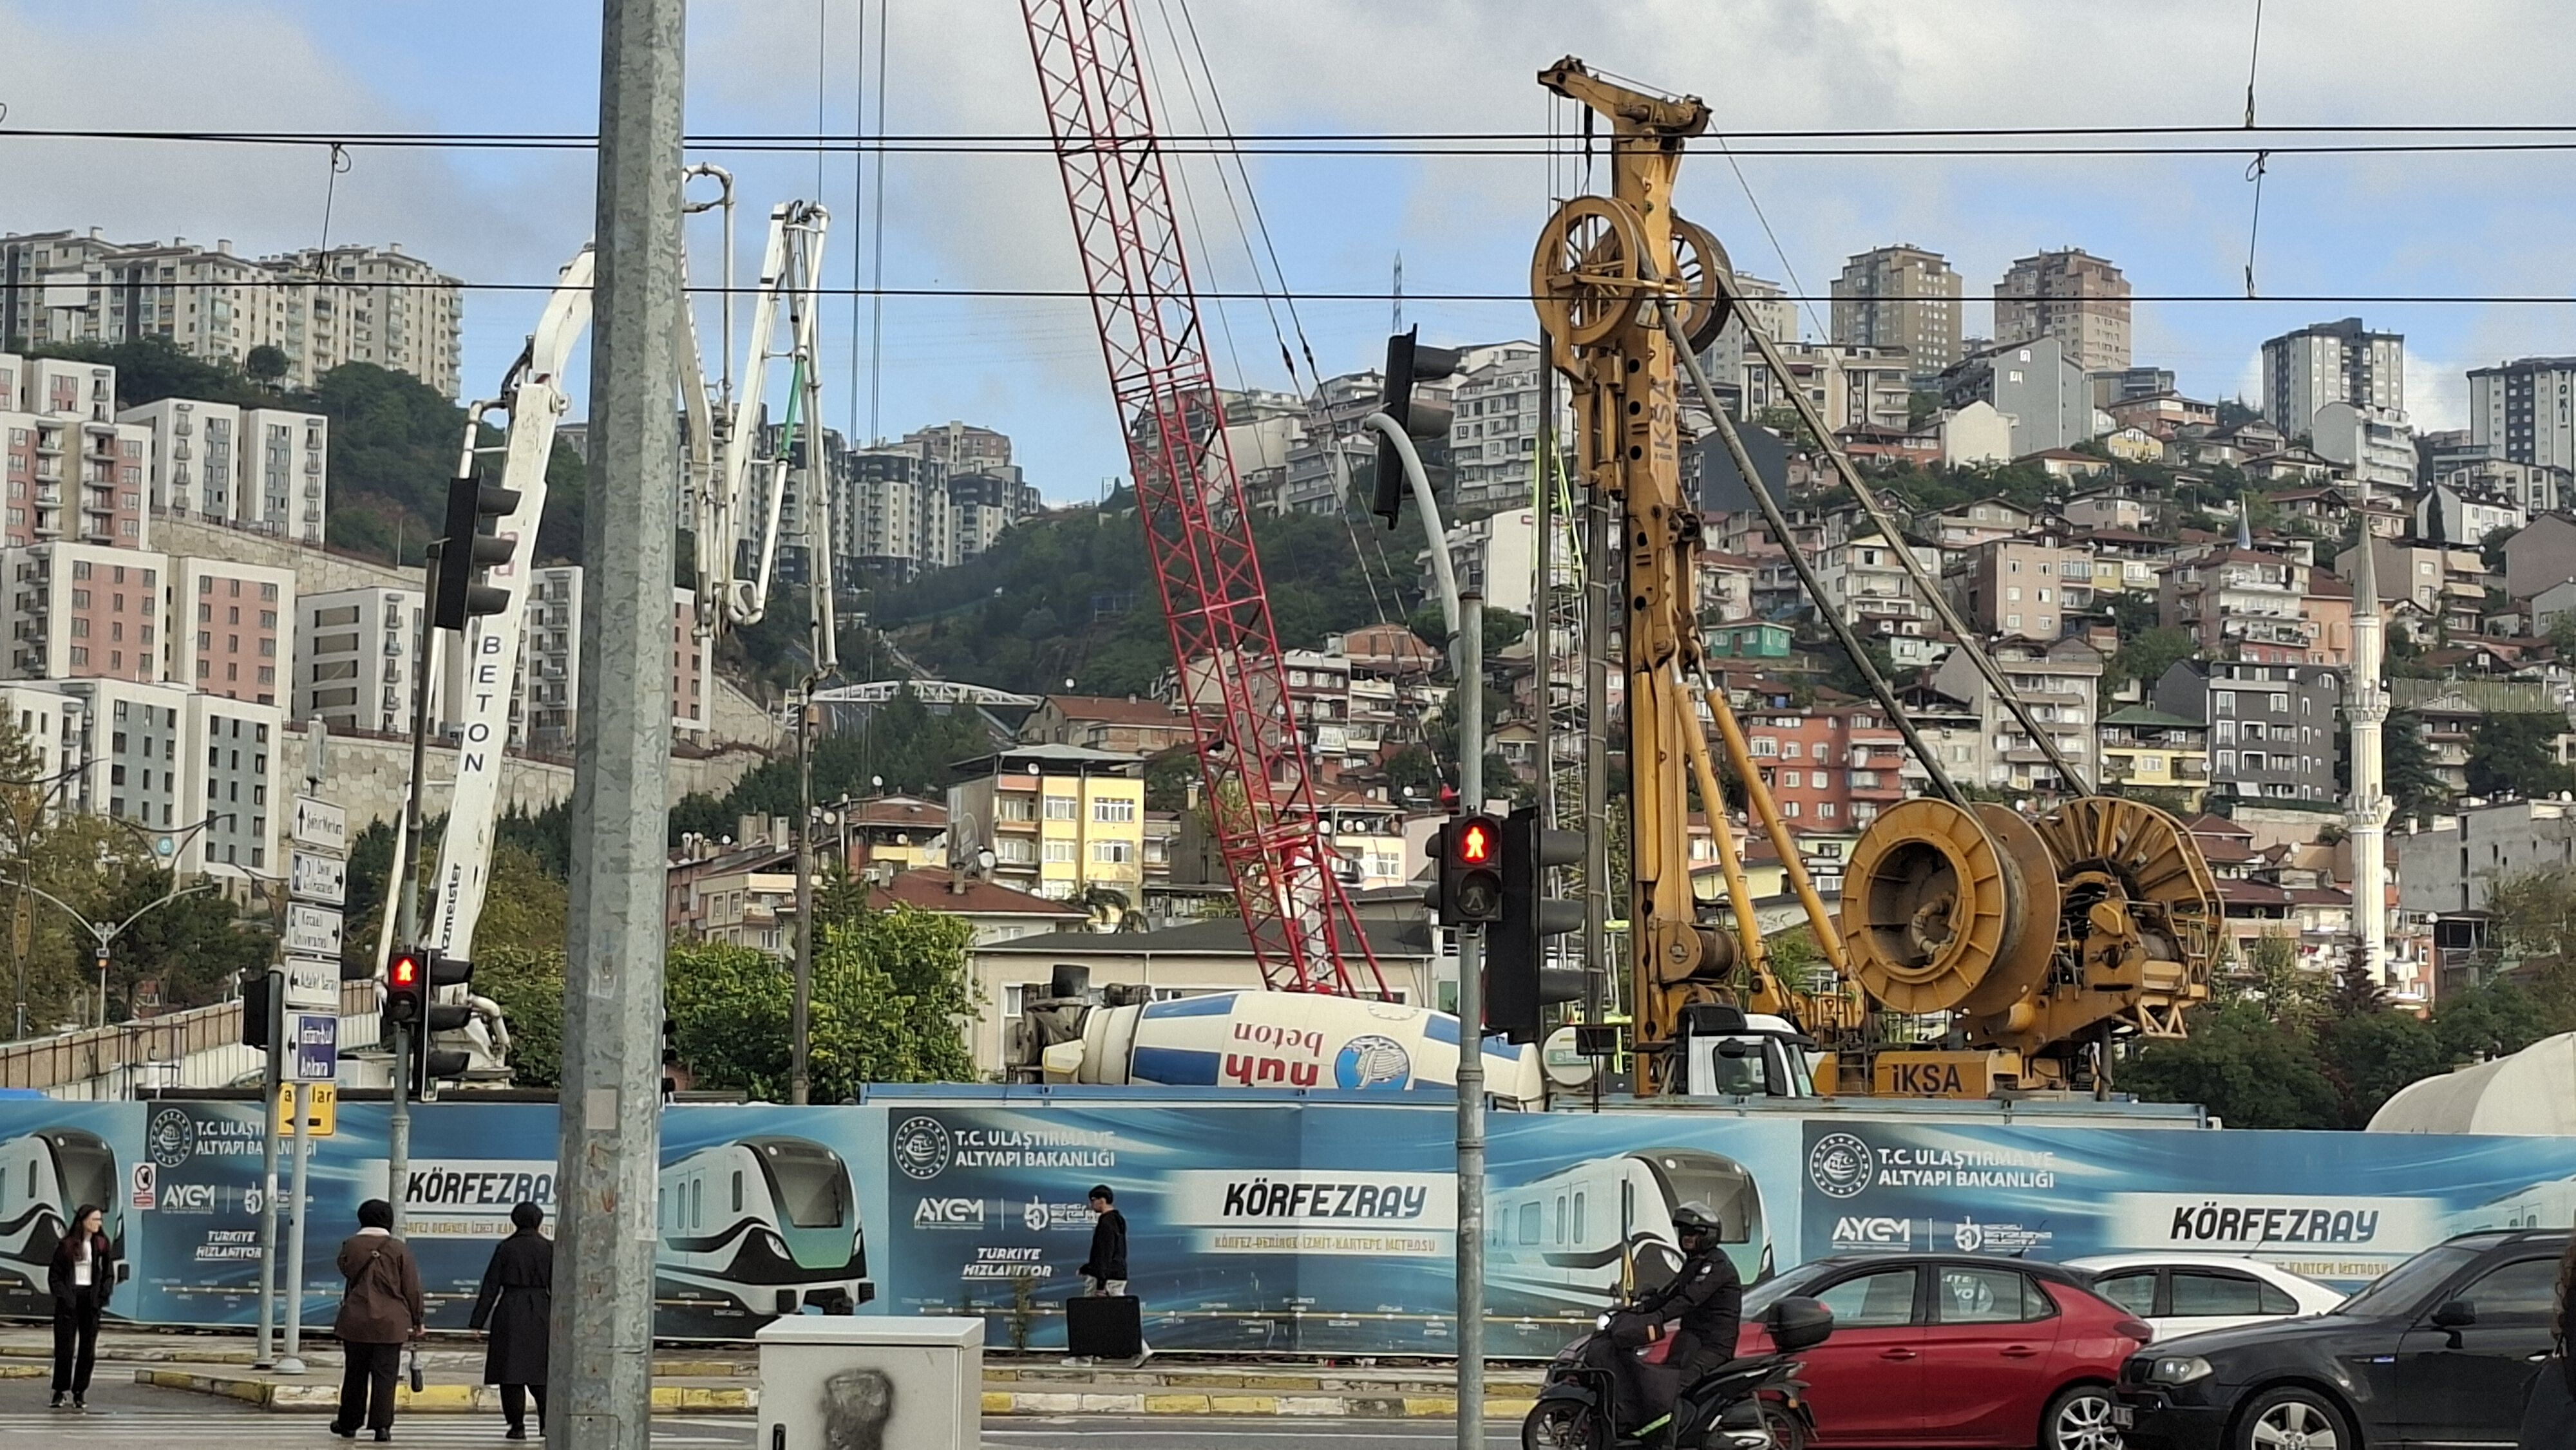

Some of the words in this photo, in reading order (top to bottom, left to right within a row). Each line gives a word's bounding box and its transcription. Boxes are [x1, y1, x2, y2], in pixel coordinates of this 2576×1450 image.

[464, 636, 501, 772] BETON
[1234, 1023, 1323, 1057] beton
[1225, 1053, 1318, 1086] nuh
[195, 1141, 244, 1155] ALTYAPI
[955, 1151, 1020, 1167] ALTYAPI
[1025, 1149, 1115, 1167] BAKANLIĞI
[1915, 1149, 2024, 1169] ULAŞTIRMA
[406, 1167, 556, 1205] KÖRFEZRA
[1878, 1169, 1951, 1186] ALTYAPI
[1956, 1170, 2054, 1188] BAKANLIĞI
[1223, 1178, 1426, 1218] KÖRFEZRAY
[2170, 1201, 2379, 1243] KÖRFEZRAY
